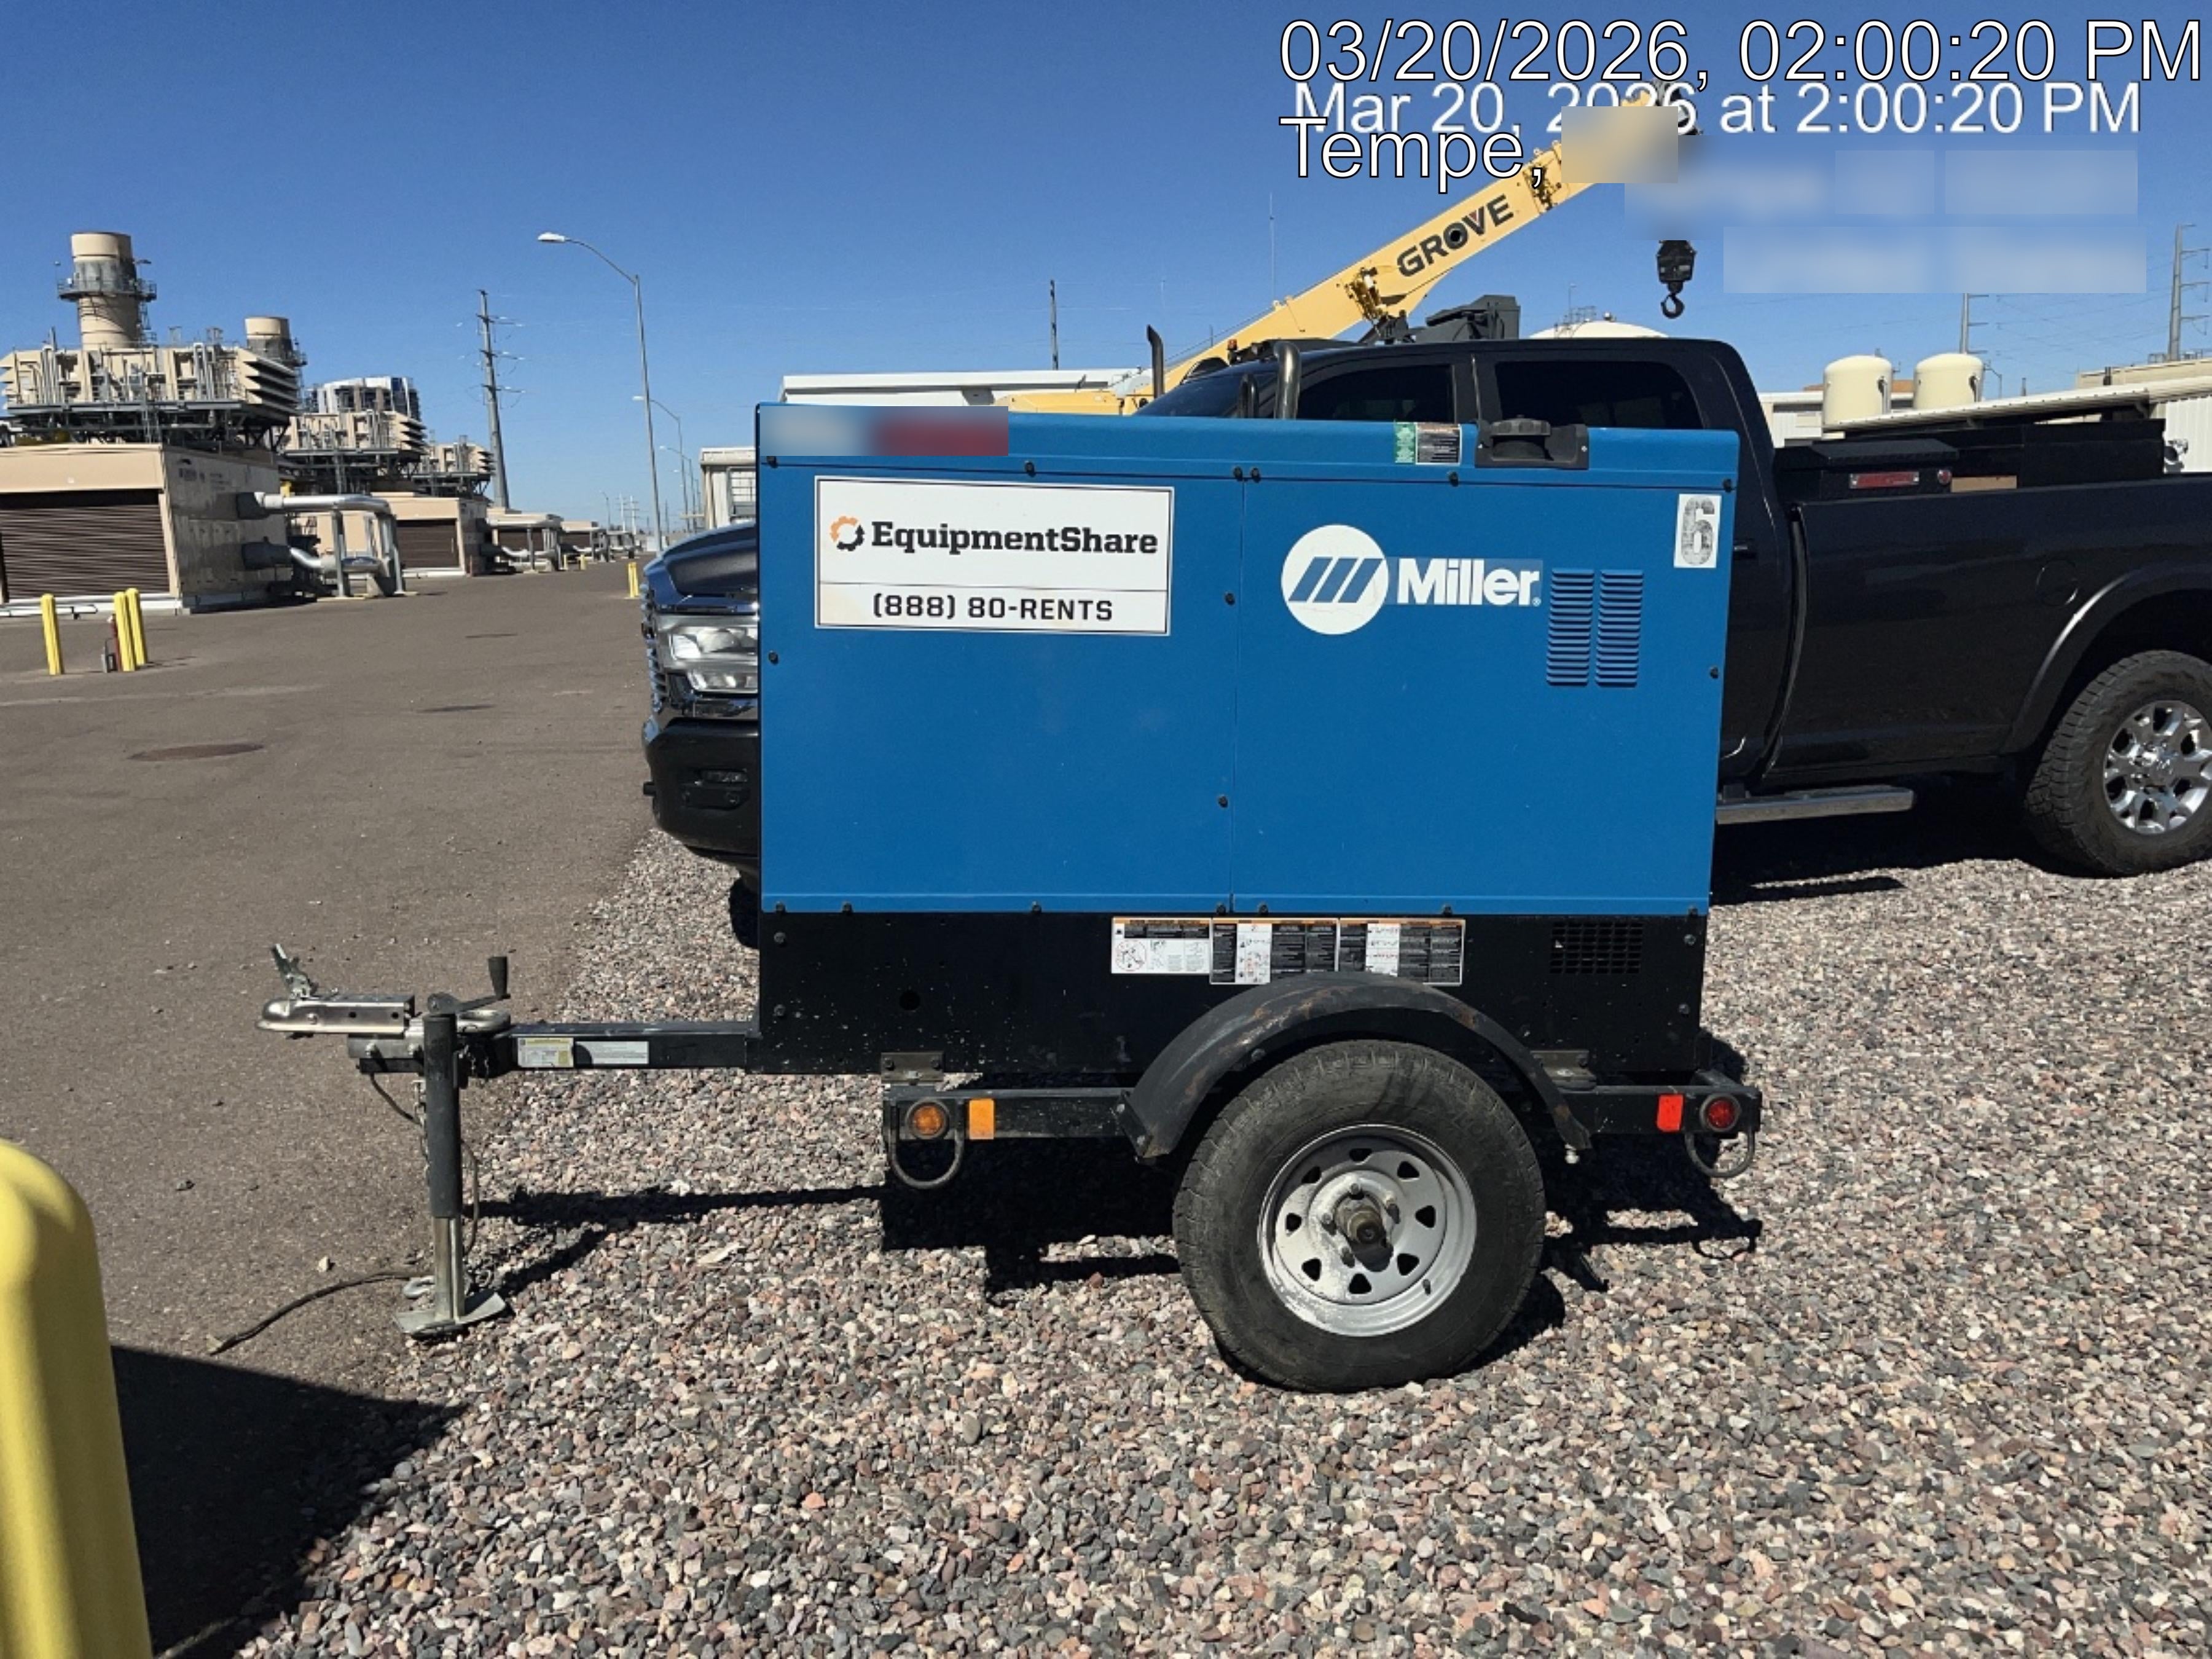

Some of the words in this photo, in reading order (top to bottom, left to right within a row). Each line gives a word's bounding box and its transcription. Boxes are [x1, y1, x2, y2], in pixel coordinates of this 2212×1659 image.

[1397, 193, 1515, 276] GROVE
[871, 520, 1158, 555] EquipmentShare
[1681, 497, 1715, 566] 6
[873, 593, 955, 619] (888)
[968, 596, 1113, 622] 80-RENTS
